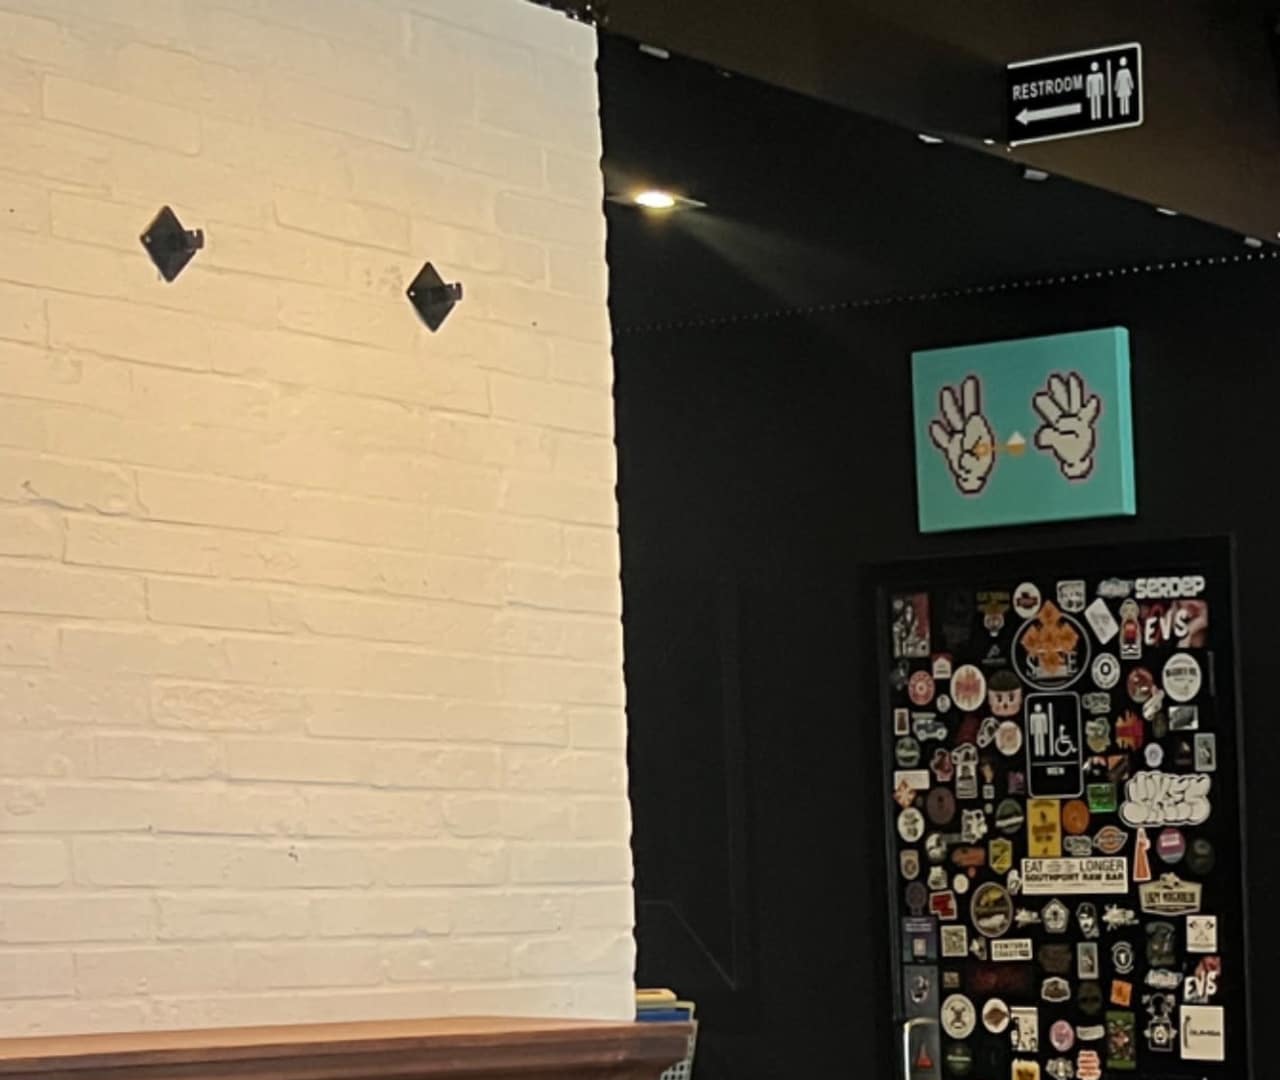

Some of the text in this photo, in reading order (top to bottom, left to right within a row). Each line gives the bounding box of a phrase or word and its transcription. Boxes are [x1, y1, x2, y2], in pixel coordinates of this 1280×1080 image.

[1012, 74, 1083, 101] RESTROOM
[1024, 860, 1042, 873] EAT
[1079, 860, 1124, 873] LONGER
[1024, 873, 1124, 882] SOUTHPORT RAW BAR
